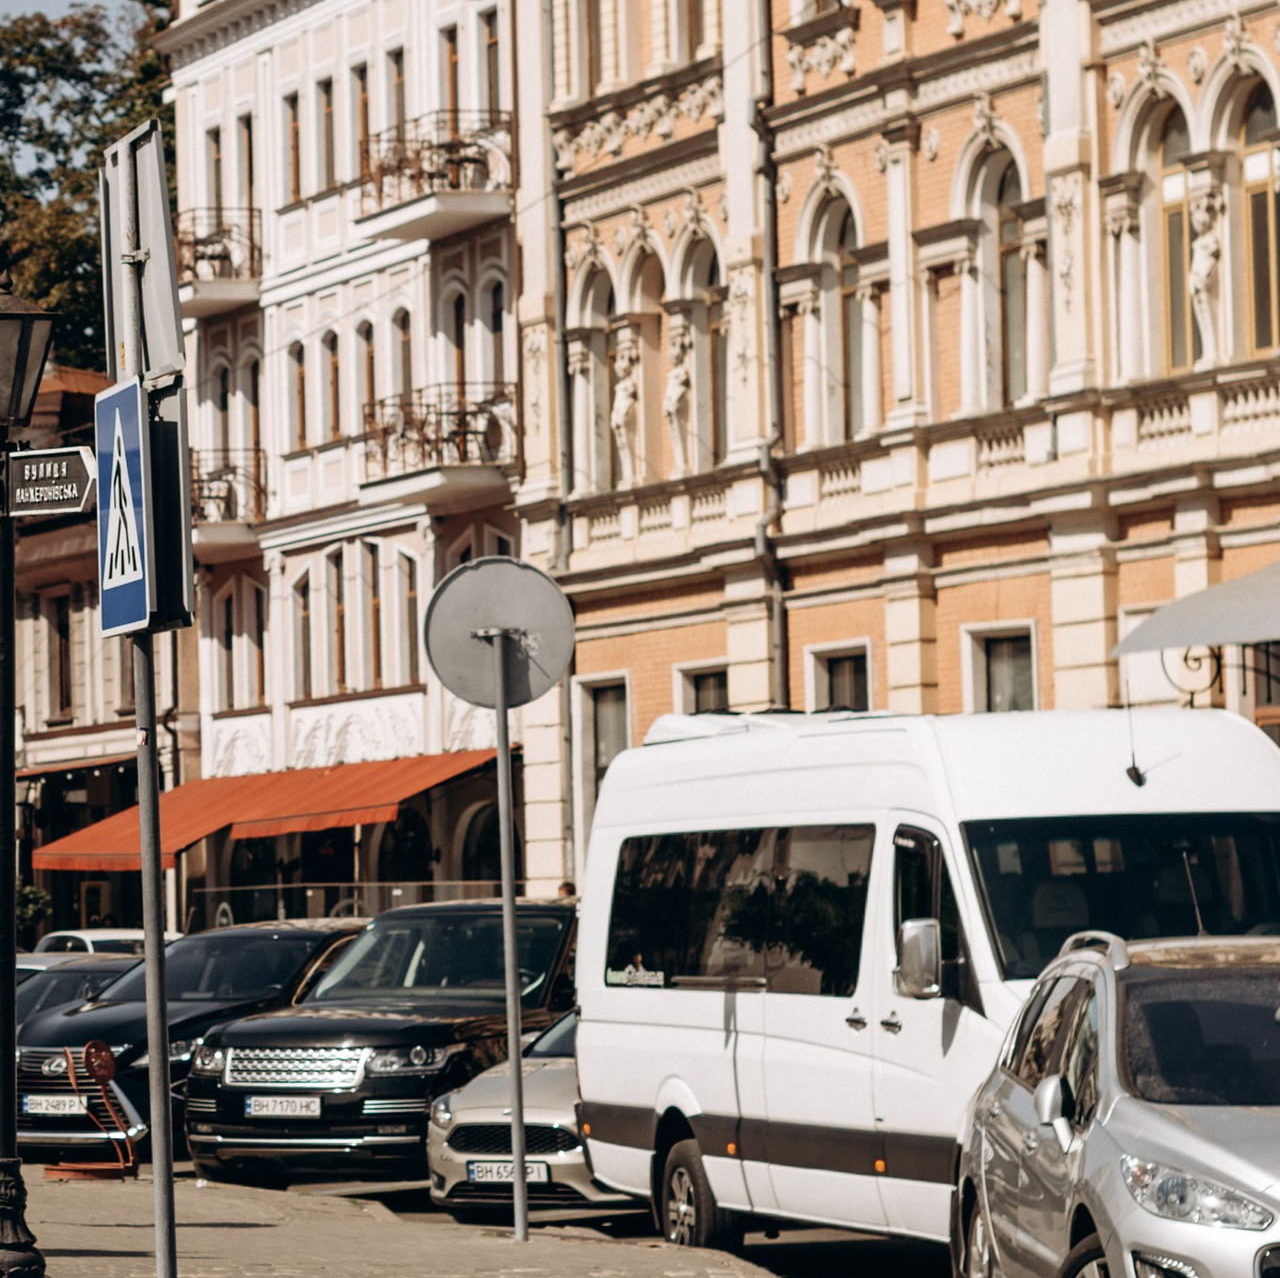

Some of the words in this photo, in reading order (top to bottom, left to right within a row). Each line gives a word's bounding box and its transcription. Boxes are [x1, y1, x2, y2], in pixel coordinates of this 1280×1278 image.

[24, 462, 68, 480] ВУЛИЦЯ
[253, 1099, 269, 1112] BH
[271, 1099, 297, 1112] 7170
[299, 1100, 316, 1113] HC
[476, 1164, 494, 1179] BH
